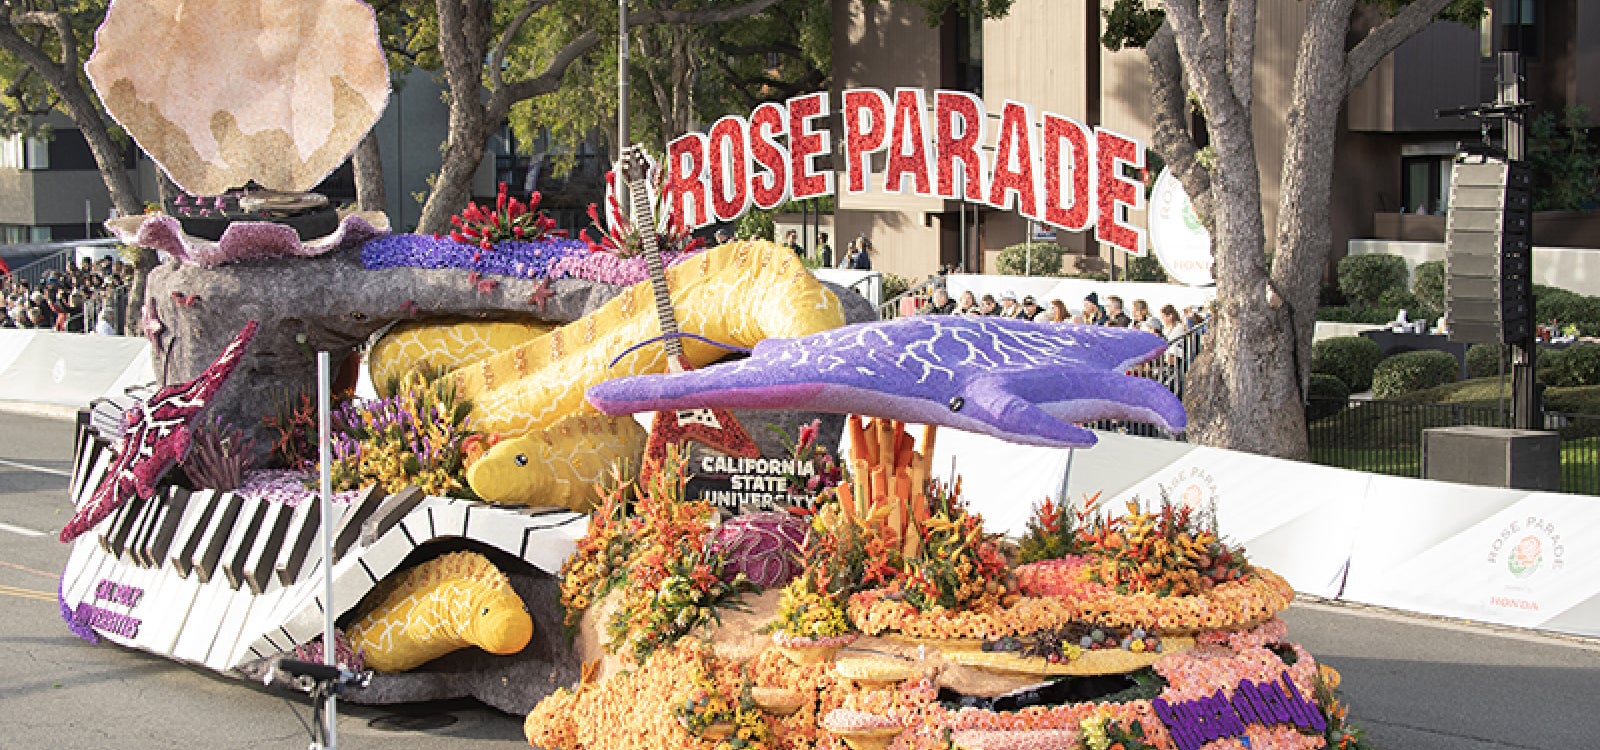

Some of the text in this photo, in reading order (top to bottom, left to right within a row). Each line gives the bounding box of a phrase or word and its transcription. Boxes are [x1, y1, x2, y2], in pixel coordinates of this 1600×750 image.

[664, 87, 1148, 256] ROSE PARADE
[701, 456, 815, 476] CALIFORNIA
[731, 474, 787, 492] STATE
[1487, 516, 1565, 570] ROSE PARADE
[1489, 596, 1540, 611] HONDA
